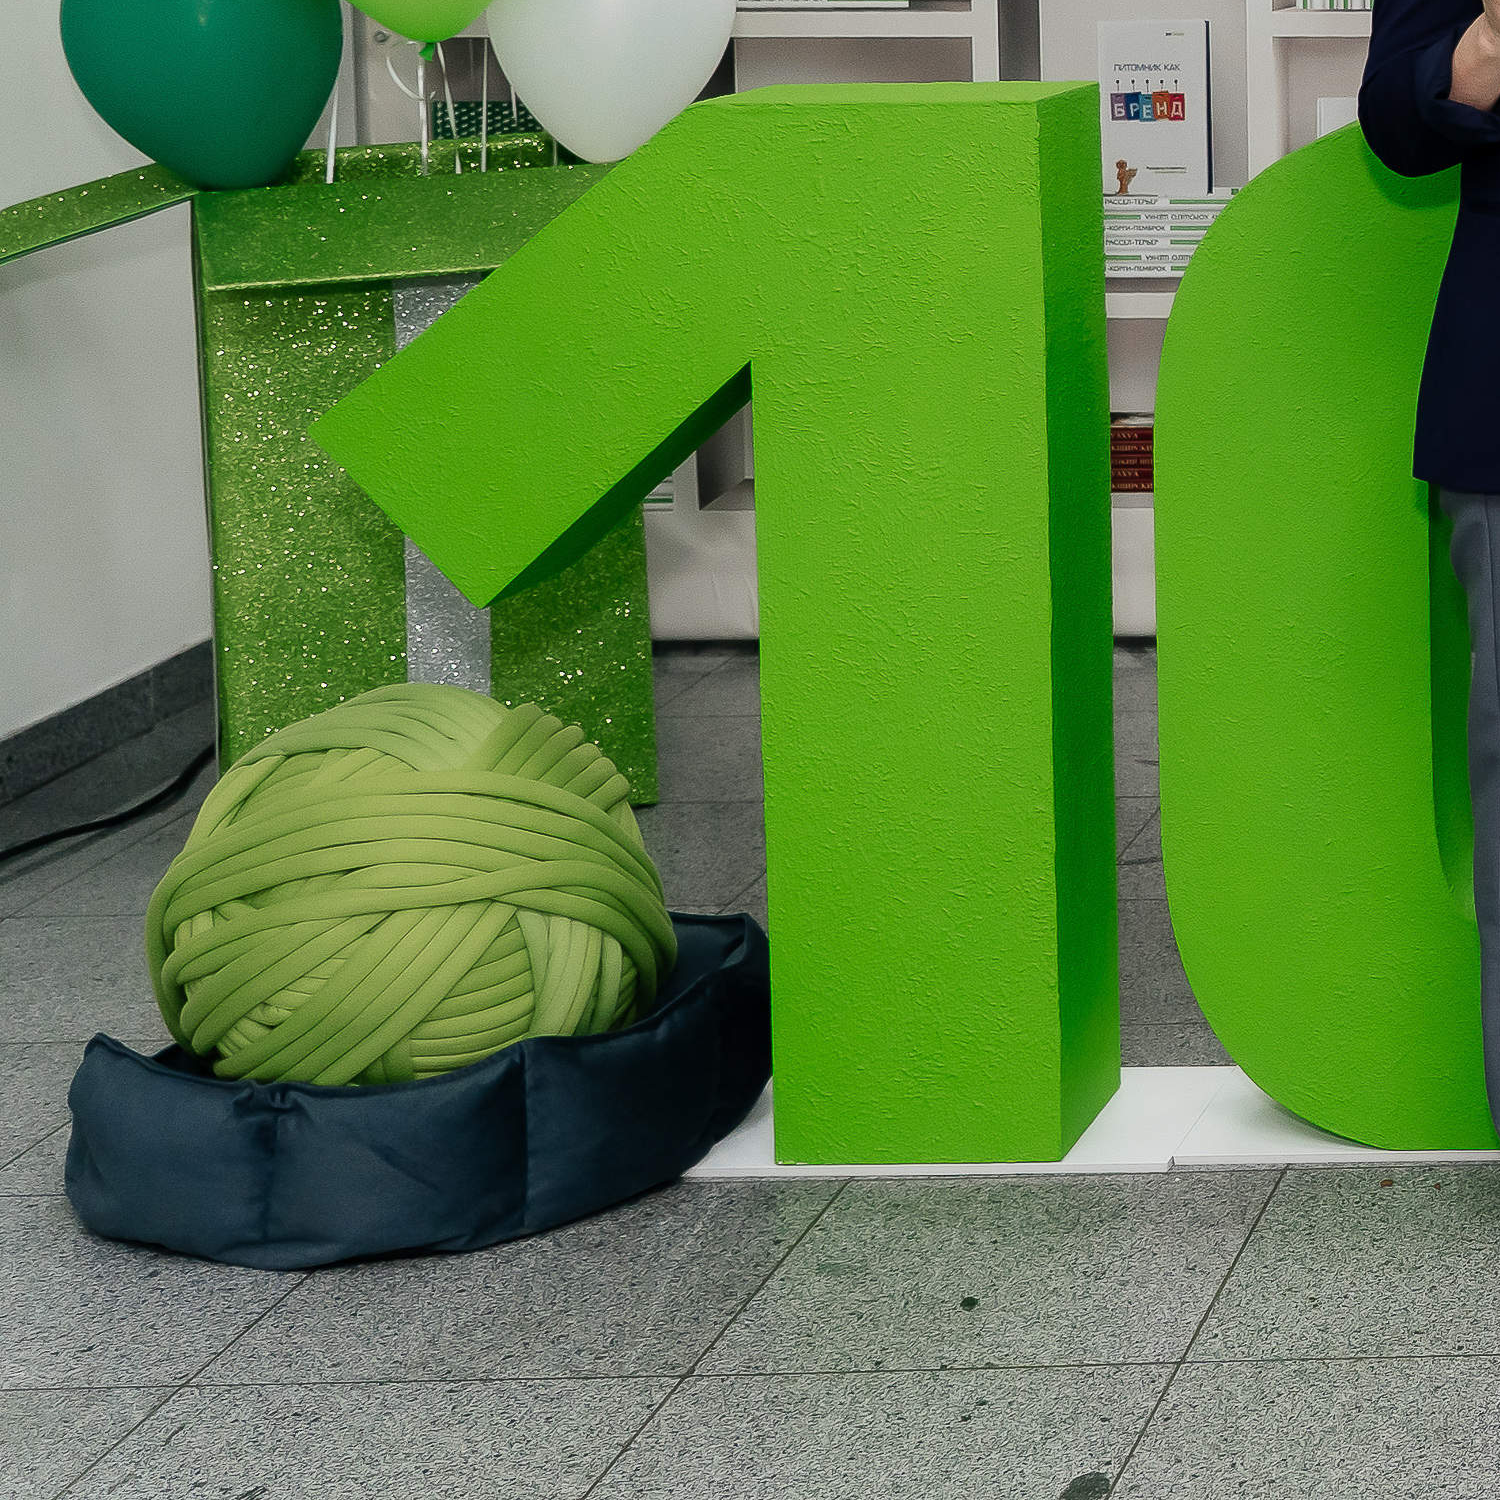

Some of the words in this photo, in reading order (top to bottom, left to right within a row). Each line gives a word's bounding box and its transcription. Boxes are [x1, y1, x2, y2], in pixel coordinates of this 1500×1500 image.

[1113, 63, 1162, 73] ПИТОМНИК
[1163, 63, 1181, 72] КАК
[1113, 101, 1184, 119] БРЕНД
